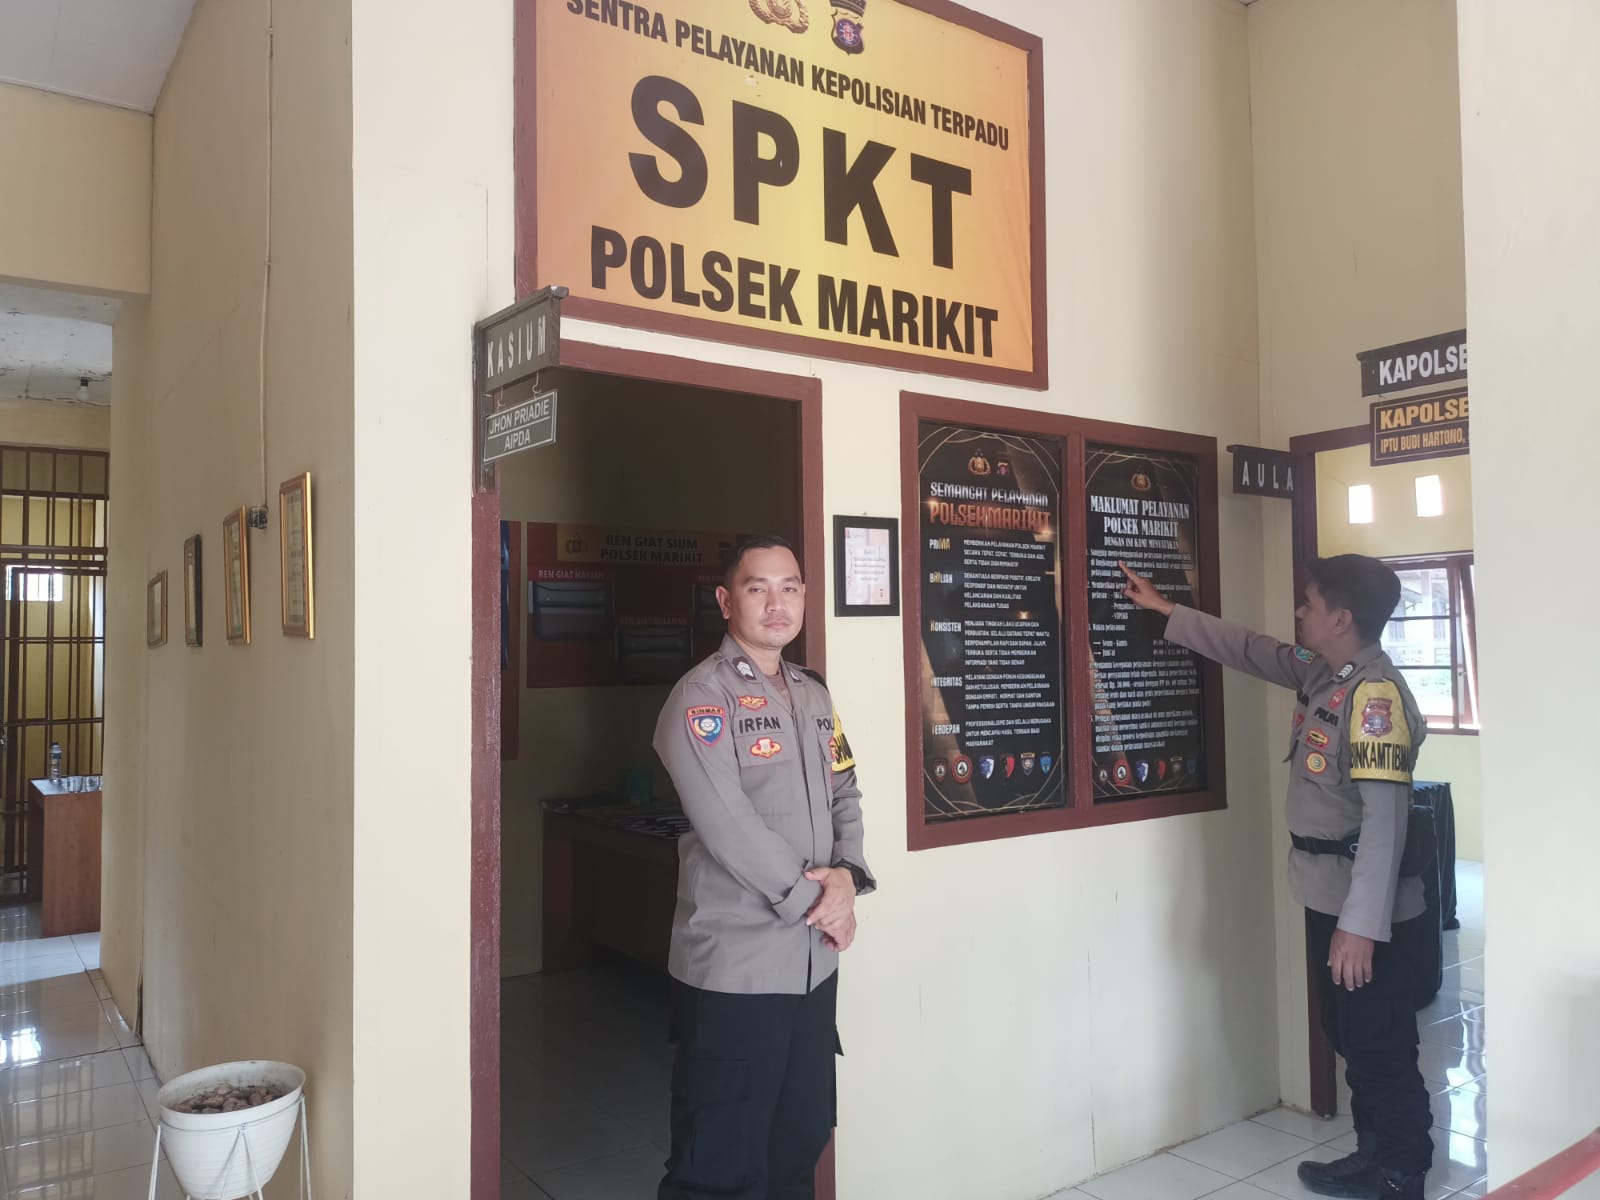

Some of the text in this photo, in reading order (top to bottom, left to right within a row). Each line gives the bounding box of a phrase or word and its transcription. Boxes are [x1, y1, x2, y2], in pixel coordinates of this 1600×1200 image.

[567, 0, 1009, 150] SENTRA PELAYANAN KEPOLISIAN TERPADU
[628, 75, 972, 269] SPKT
[591, 225, 998, 358] POLSEK MARIKIT
[487, 315, 546, 378] KASIUM
[489, 399, 549, 435] JHON PRIADIE
[504, 429, 531, 451] AIPDA
[1381, 427, 1465, 454] IPTU BUDI HARTONO,
[1241, 460, 1294, 491] AULA
[930, 481, 1048, 507] SEMANGAT PELAYANAN
[1090, 495, 1190, 519] MAKLUMAT PELAYANAN
[929, 502, 1050, 532] POLSEK MARIKIT
[1103, 516, 1178, 537] POLSEK MARIKIT
[601, 548, 652, 561] POLSEK
[635, 536, 663, 549] GIAT
[666, 538, 698, 550] SIUM
[930, 620, 962, 632] KONSISTEN
[930, 676, 963, 688] INTEGRITAS
[738, 716, 781, 734] IRFAN
